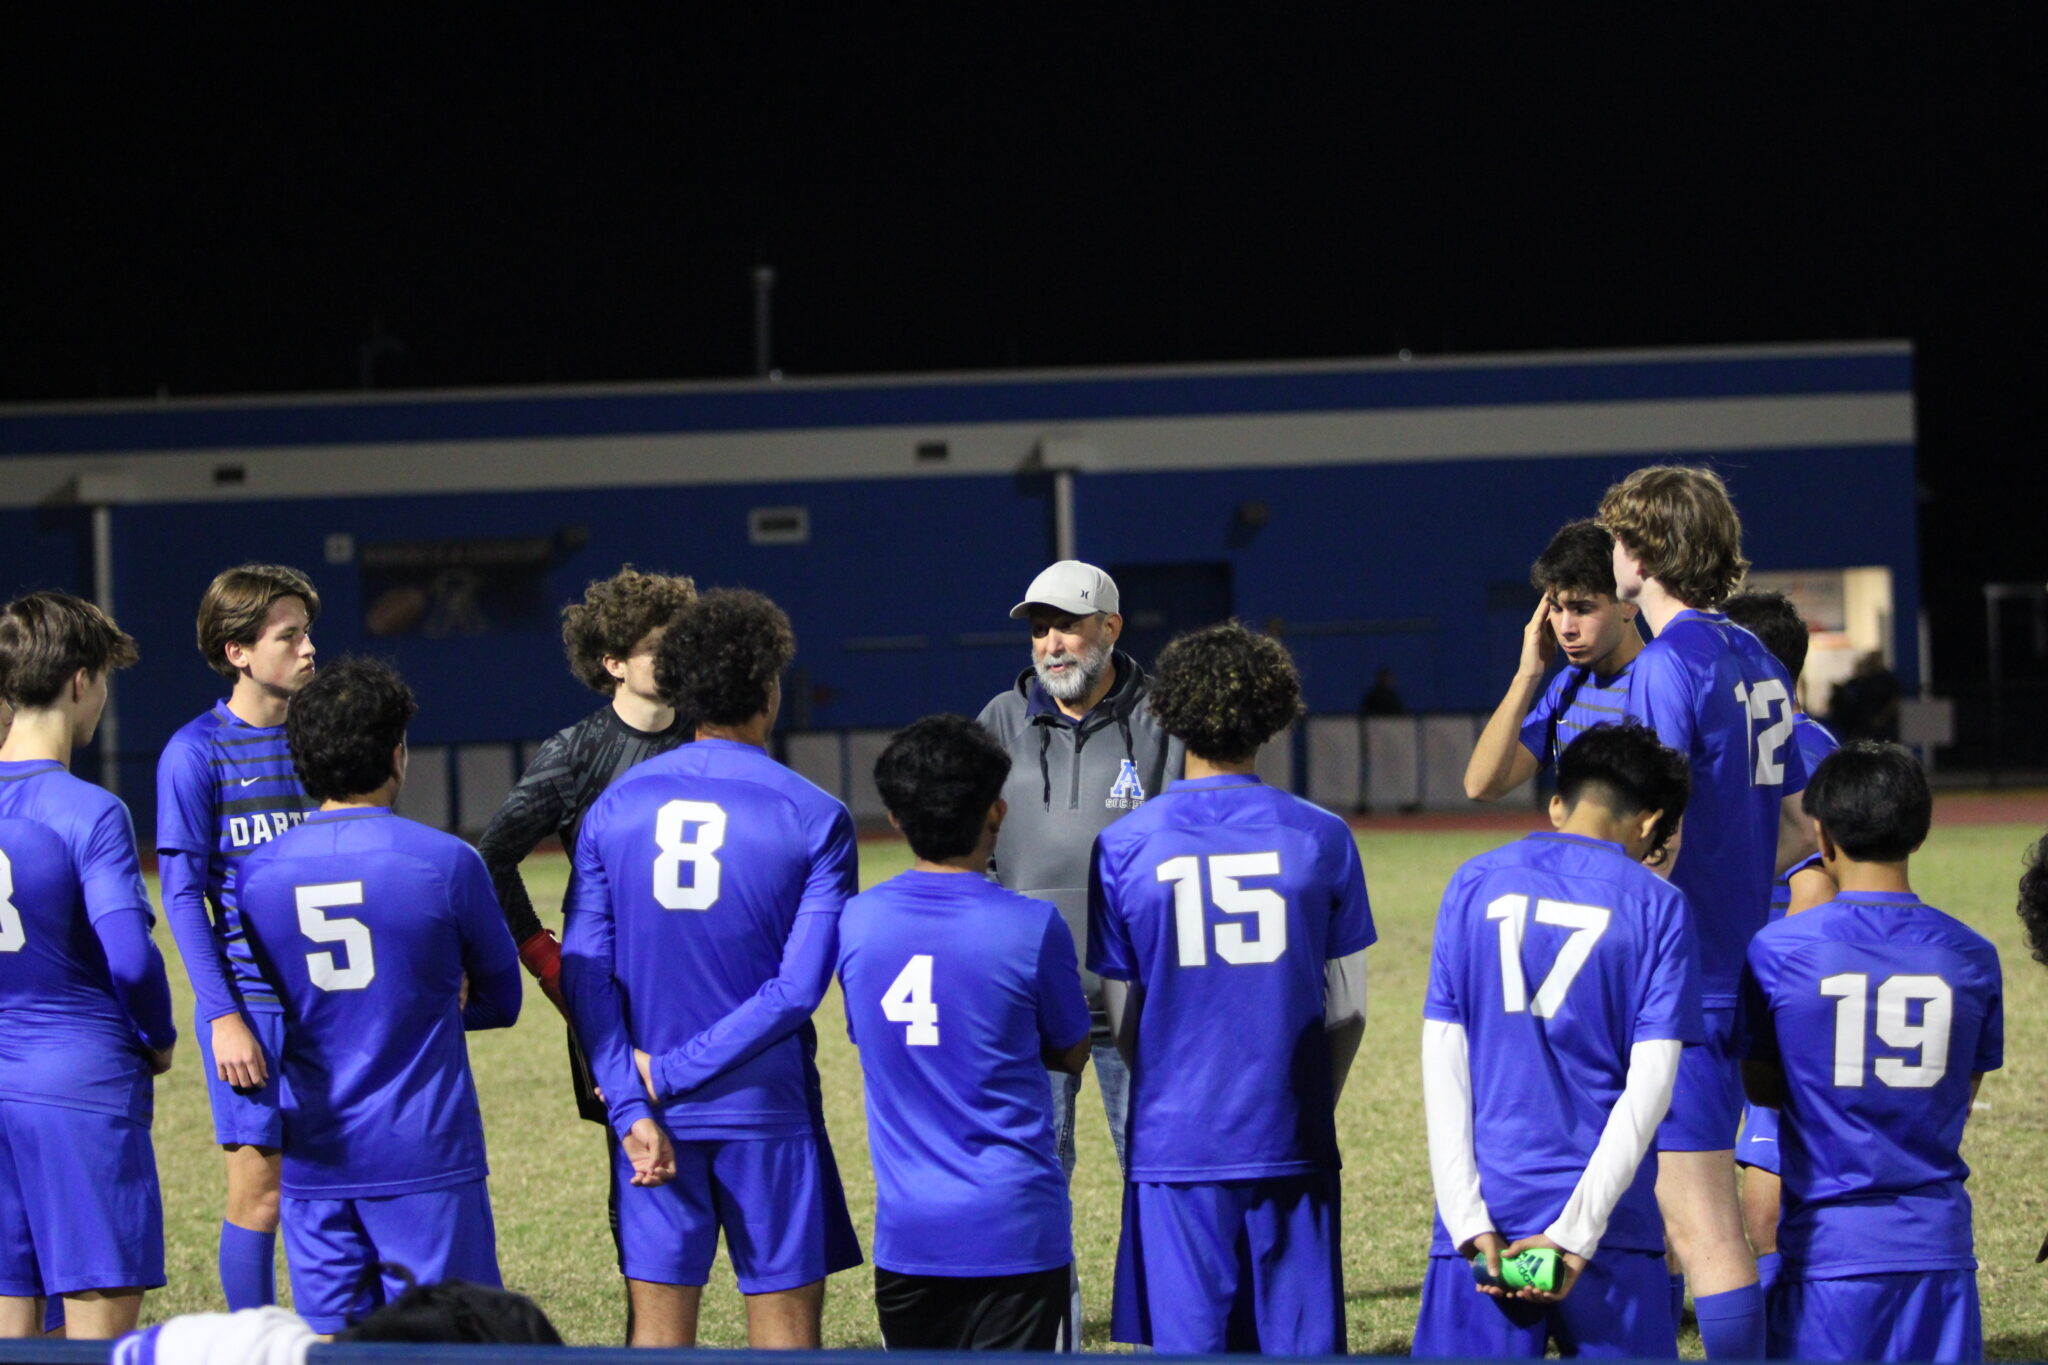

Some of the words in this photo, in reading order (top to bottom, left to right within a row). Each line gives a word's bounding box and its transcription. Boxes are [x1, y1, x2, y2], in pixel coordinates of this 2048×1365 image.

[1110, 758, 1145, 801] A
[1735, 678, 1794, 786] 12
[652, 797, 731, 911] 8
[1155, 849, 1287, 968] 15
[294, 880, 375, 992] 5
[1484, 888, 1613, 1021] 17
[880, 954, 940, 1047] 4
[1820, 972, 1953, 1089] 19
